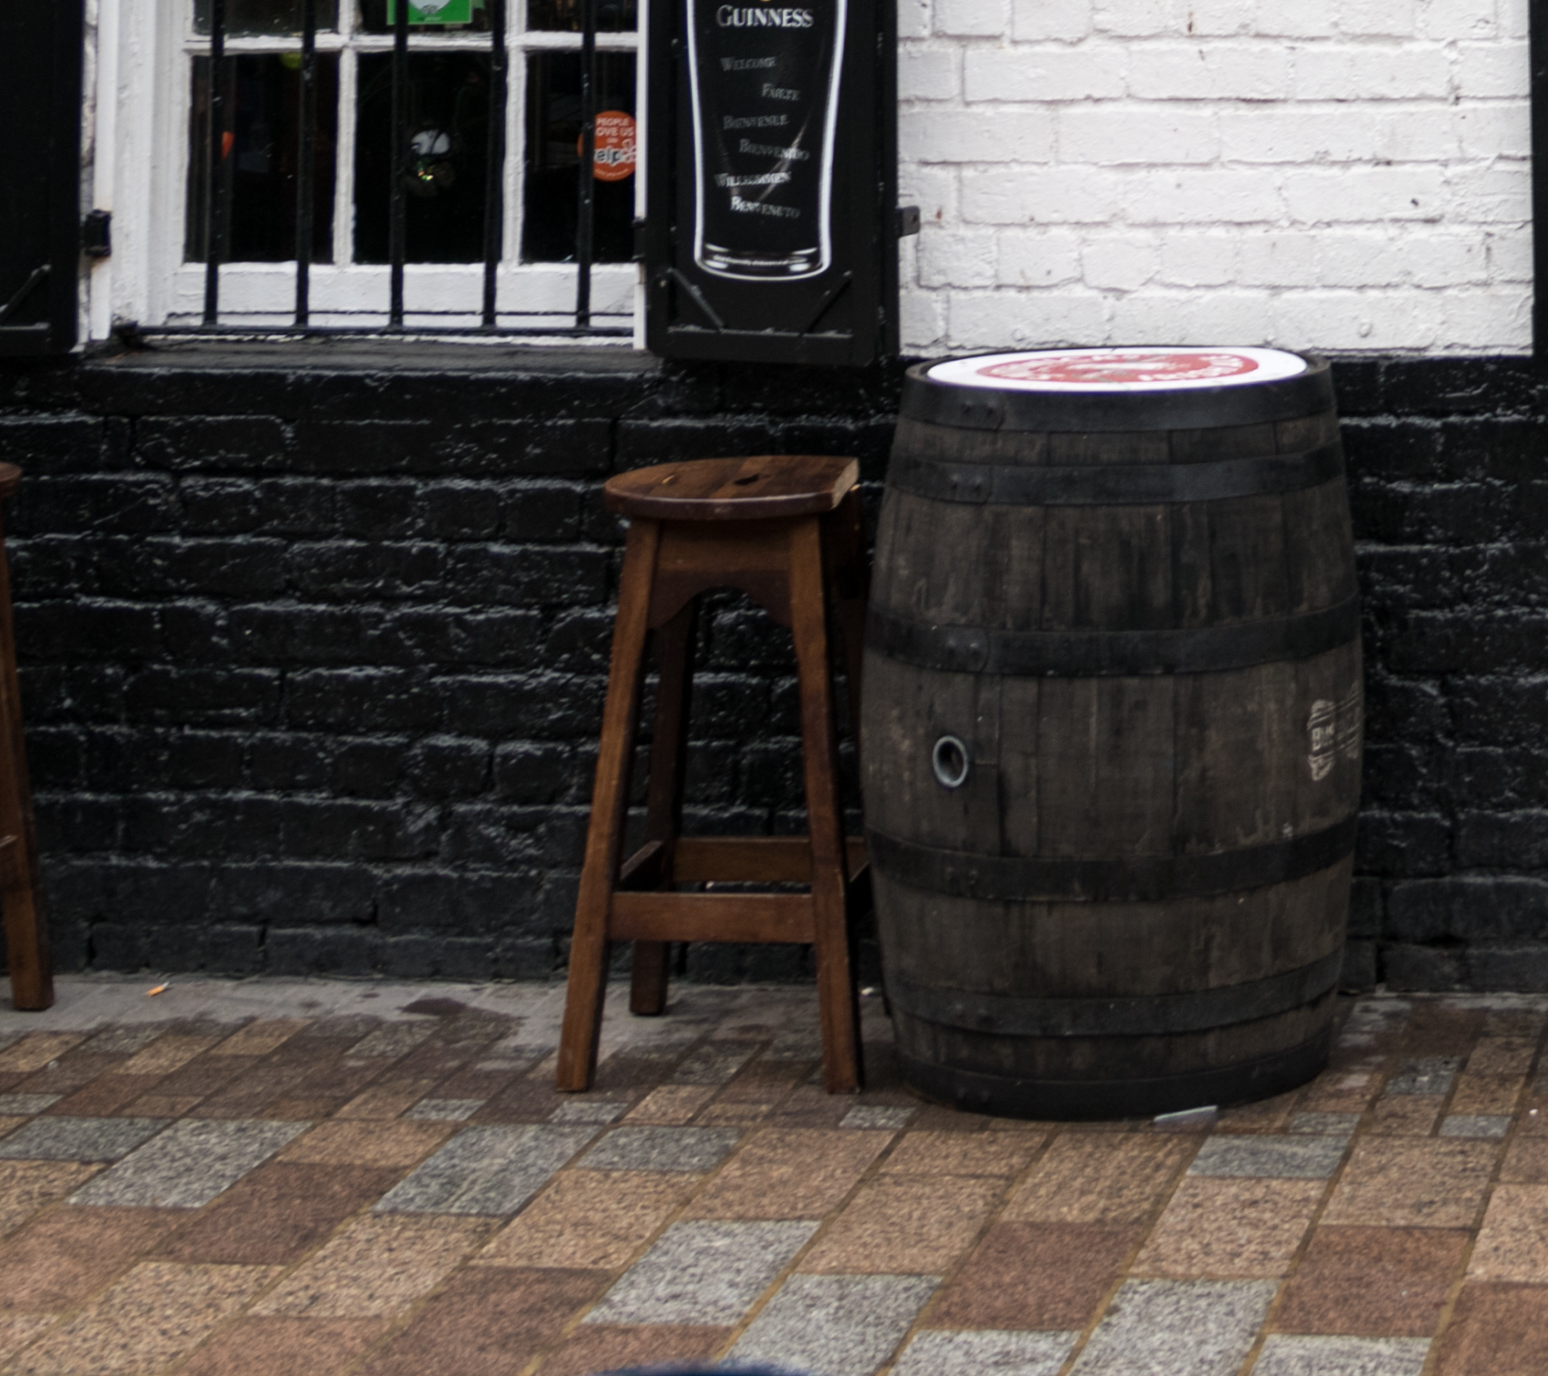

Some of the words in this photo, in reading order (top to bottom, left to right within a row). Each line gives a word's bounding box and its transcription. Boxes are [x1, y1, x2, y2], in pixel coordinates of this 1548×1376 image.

[716, 4, 814, 28] GUINNESS
[595, 127, 618, 137] OVE
[594, 145, 621, 167] elp
